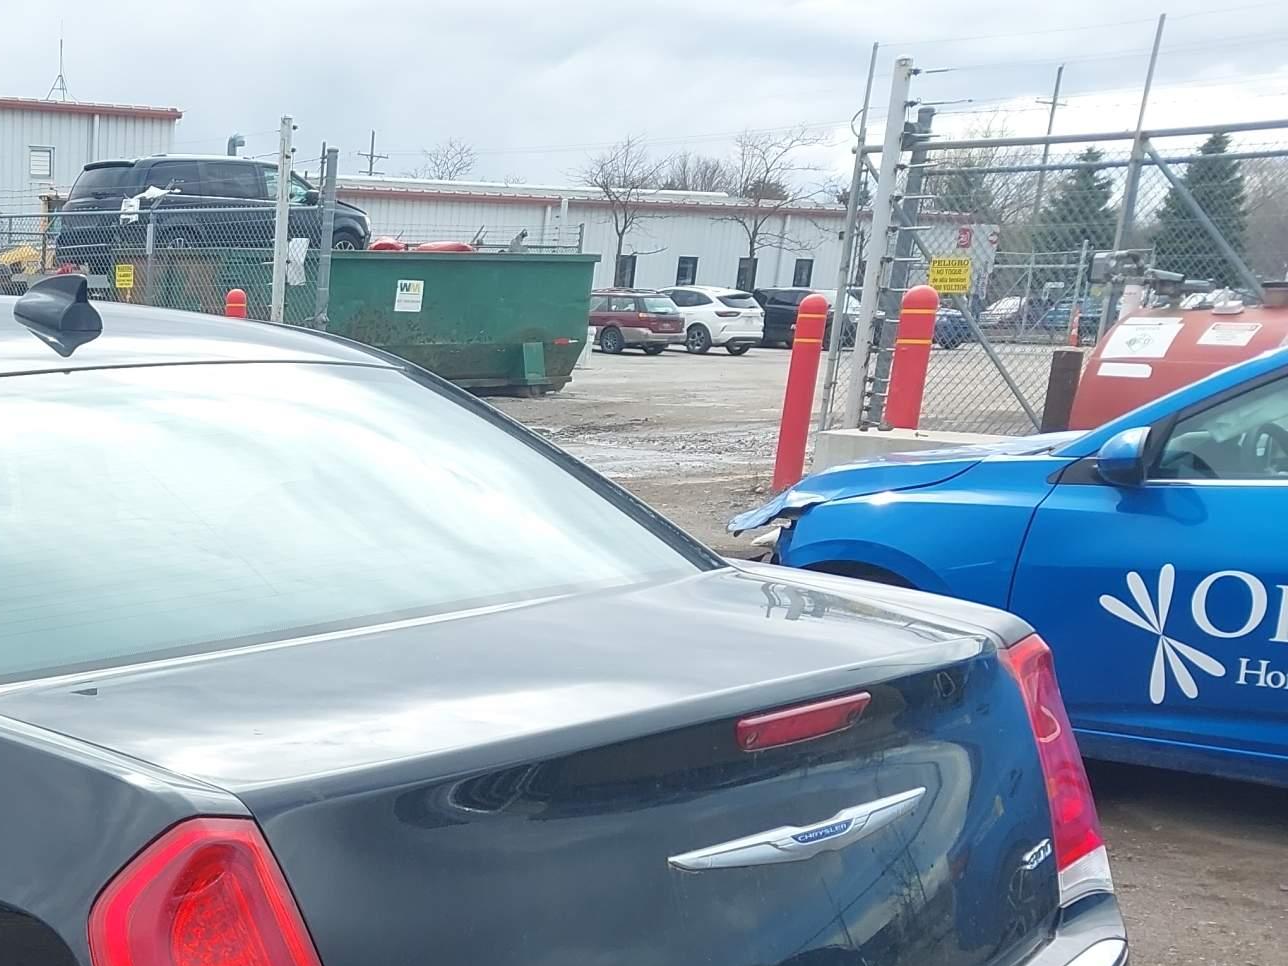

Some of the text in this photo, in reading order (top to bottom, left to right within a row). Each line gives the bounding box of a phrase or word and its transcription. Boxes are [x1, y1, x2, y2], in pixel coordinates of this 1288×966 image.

[932, 259, 970, 267] PELIGRO
[399, 282, 421, 293] WM
[798, 823, 847, 841] CHRYSLER
[1021, 838, 1052, 870] 300
